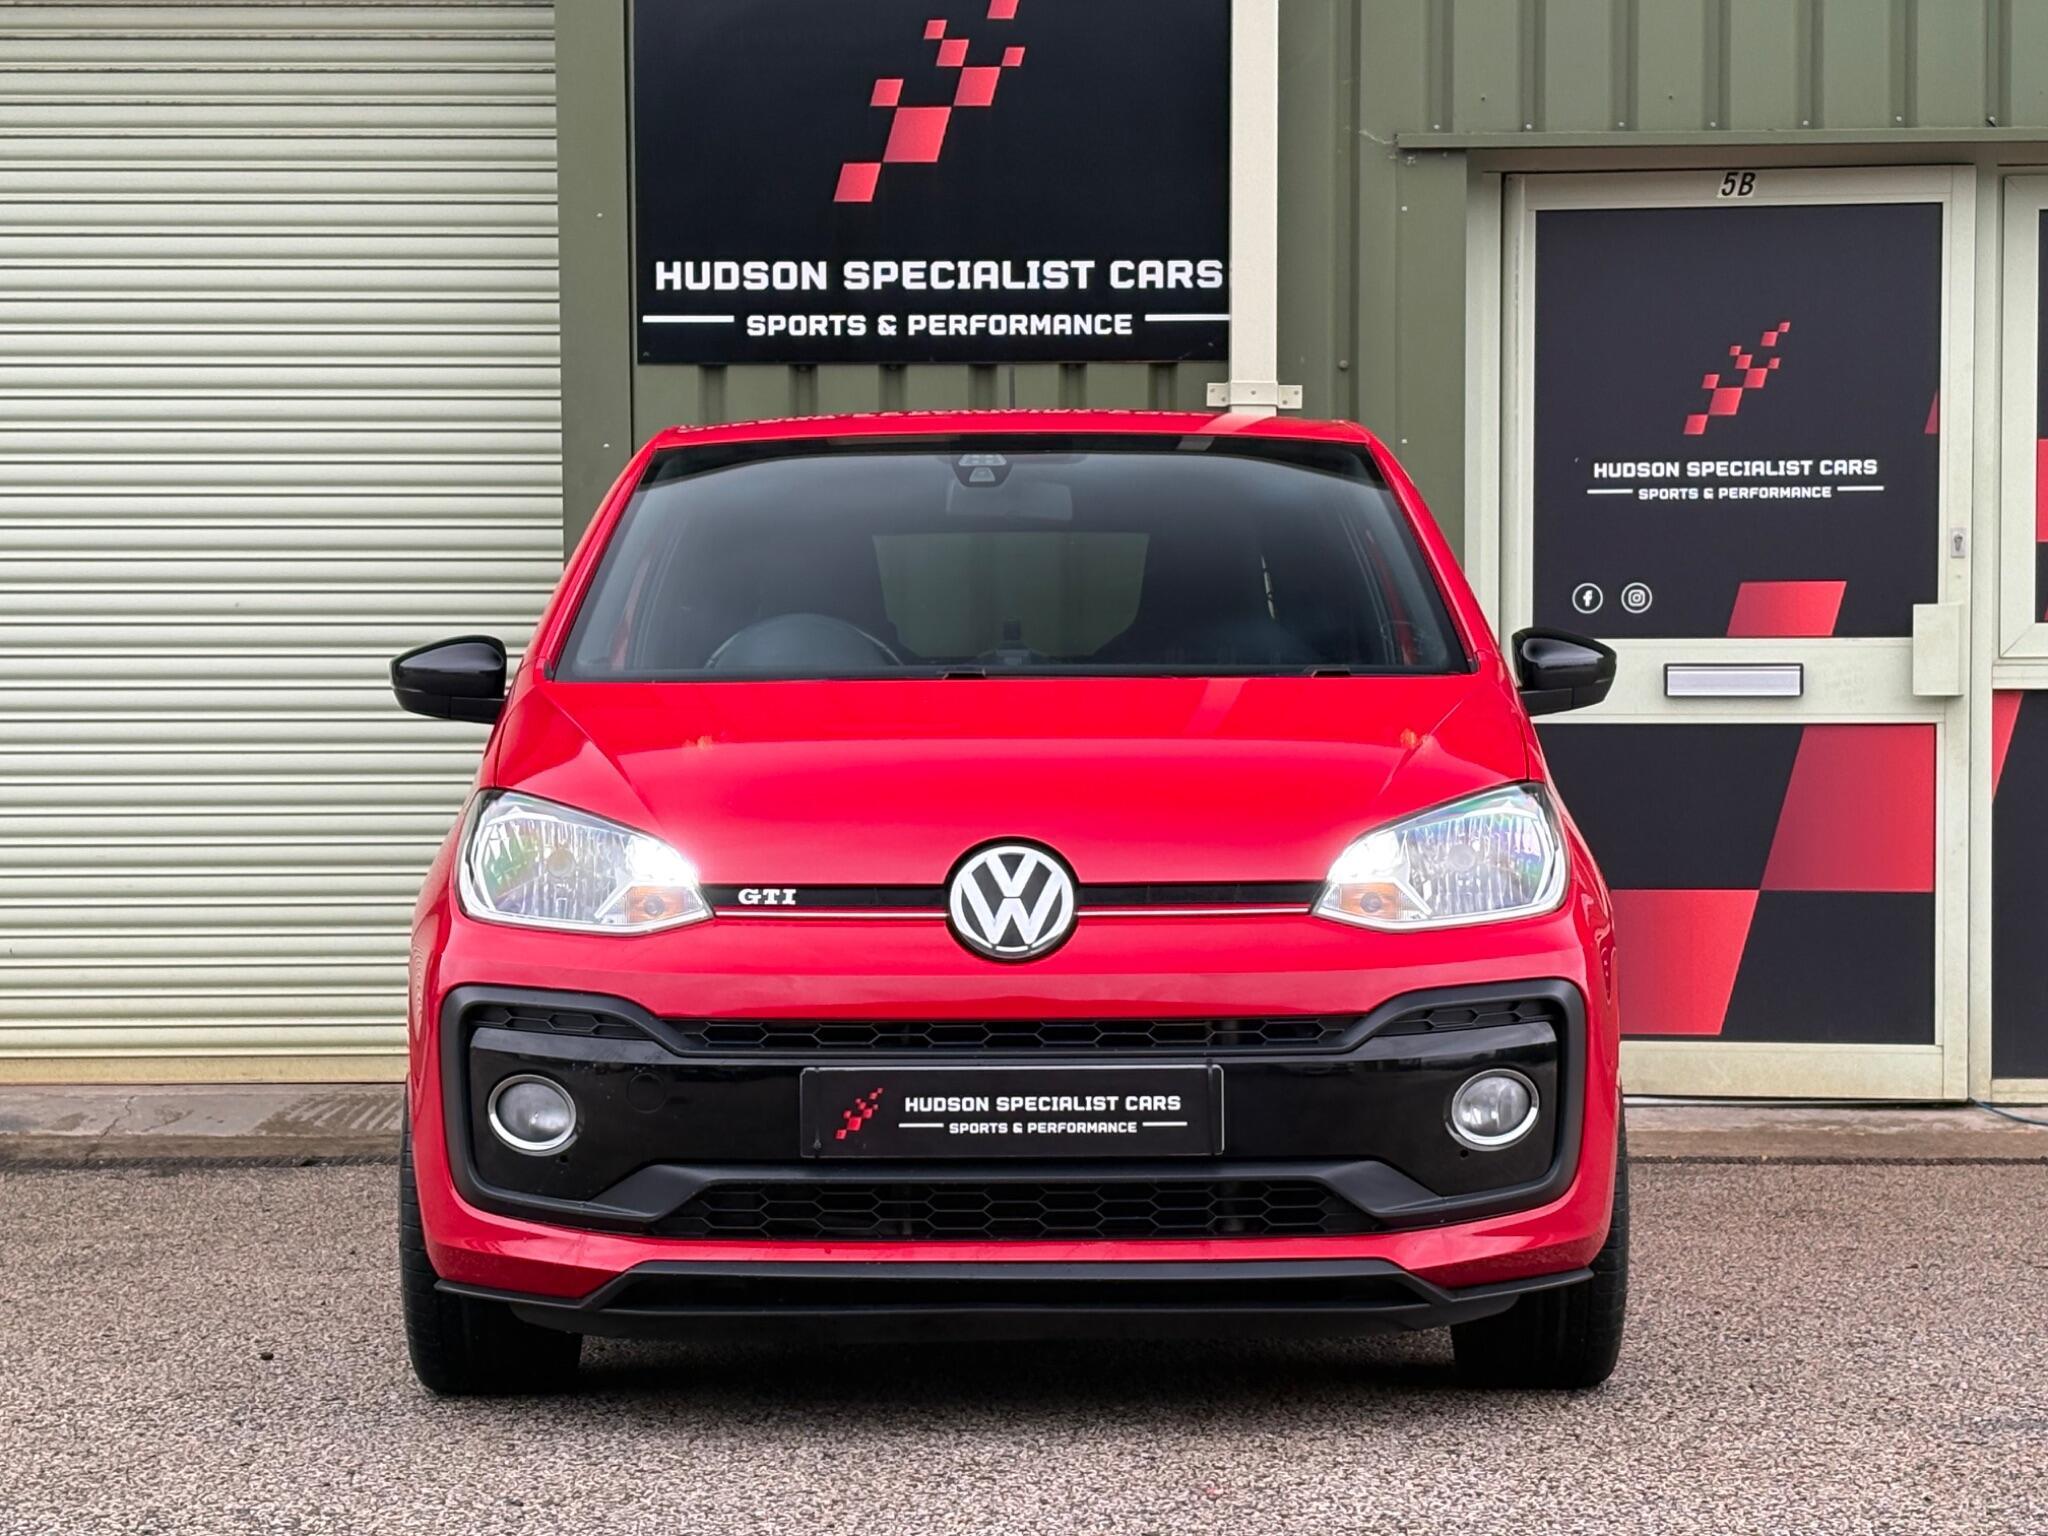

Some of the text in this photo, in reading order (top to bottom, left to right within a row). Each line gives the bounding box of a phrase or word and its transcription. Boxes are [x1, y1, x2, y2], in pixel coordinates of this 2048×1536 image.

[1719, 171, 1757, 198] 5B
[655, 259, 1224, 291] HUDSON SPECIALIST CARS
[746, 313, 1133, 337] SPORTS & PERFORMANCE
[1593, 458, 1878, 479] HUDSON SPECIALIST CARS
[1637, 485, 1832, 501] SPORTS & PERFORMANCE
[737, 887, 797, 906] GTI
[953, 847, 1071, 949] VW
[904, 1095, 1182, 1113] HUDSON SPECIALIST CARS
[948, 1120, 1138, 1135] SPORTS & PERFORMANCE
